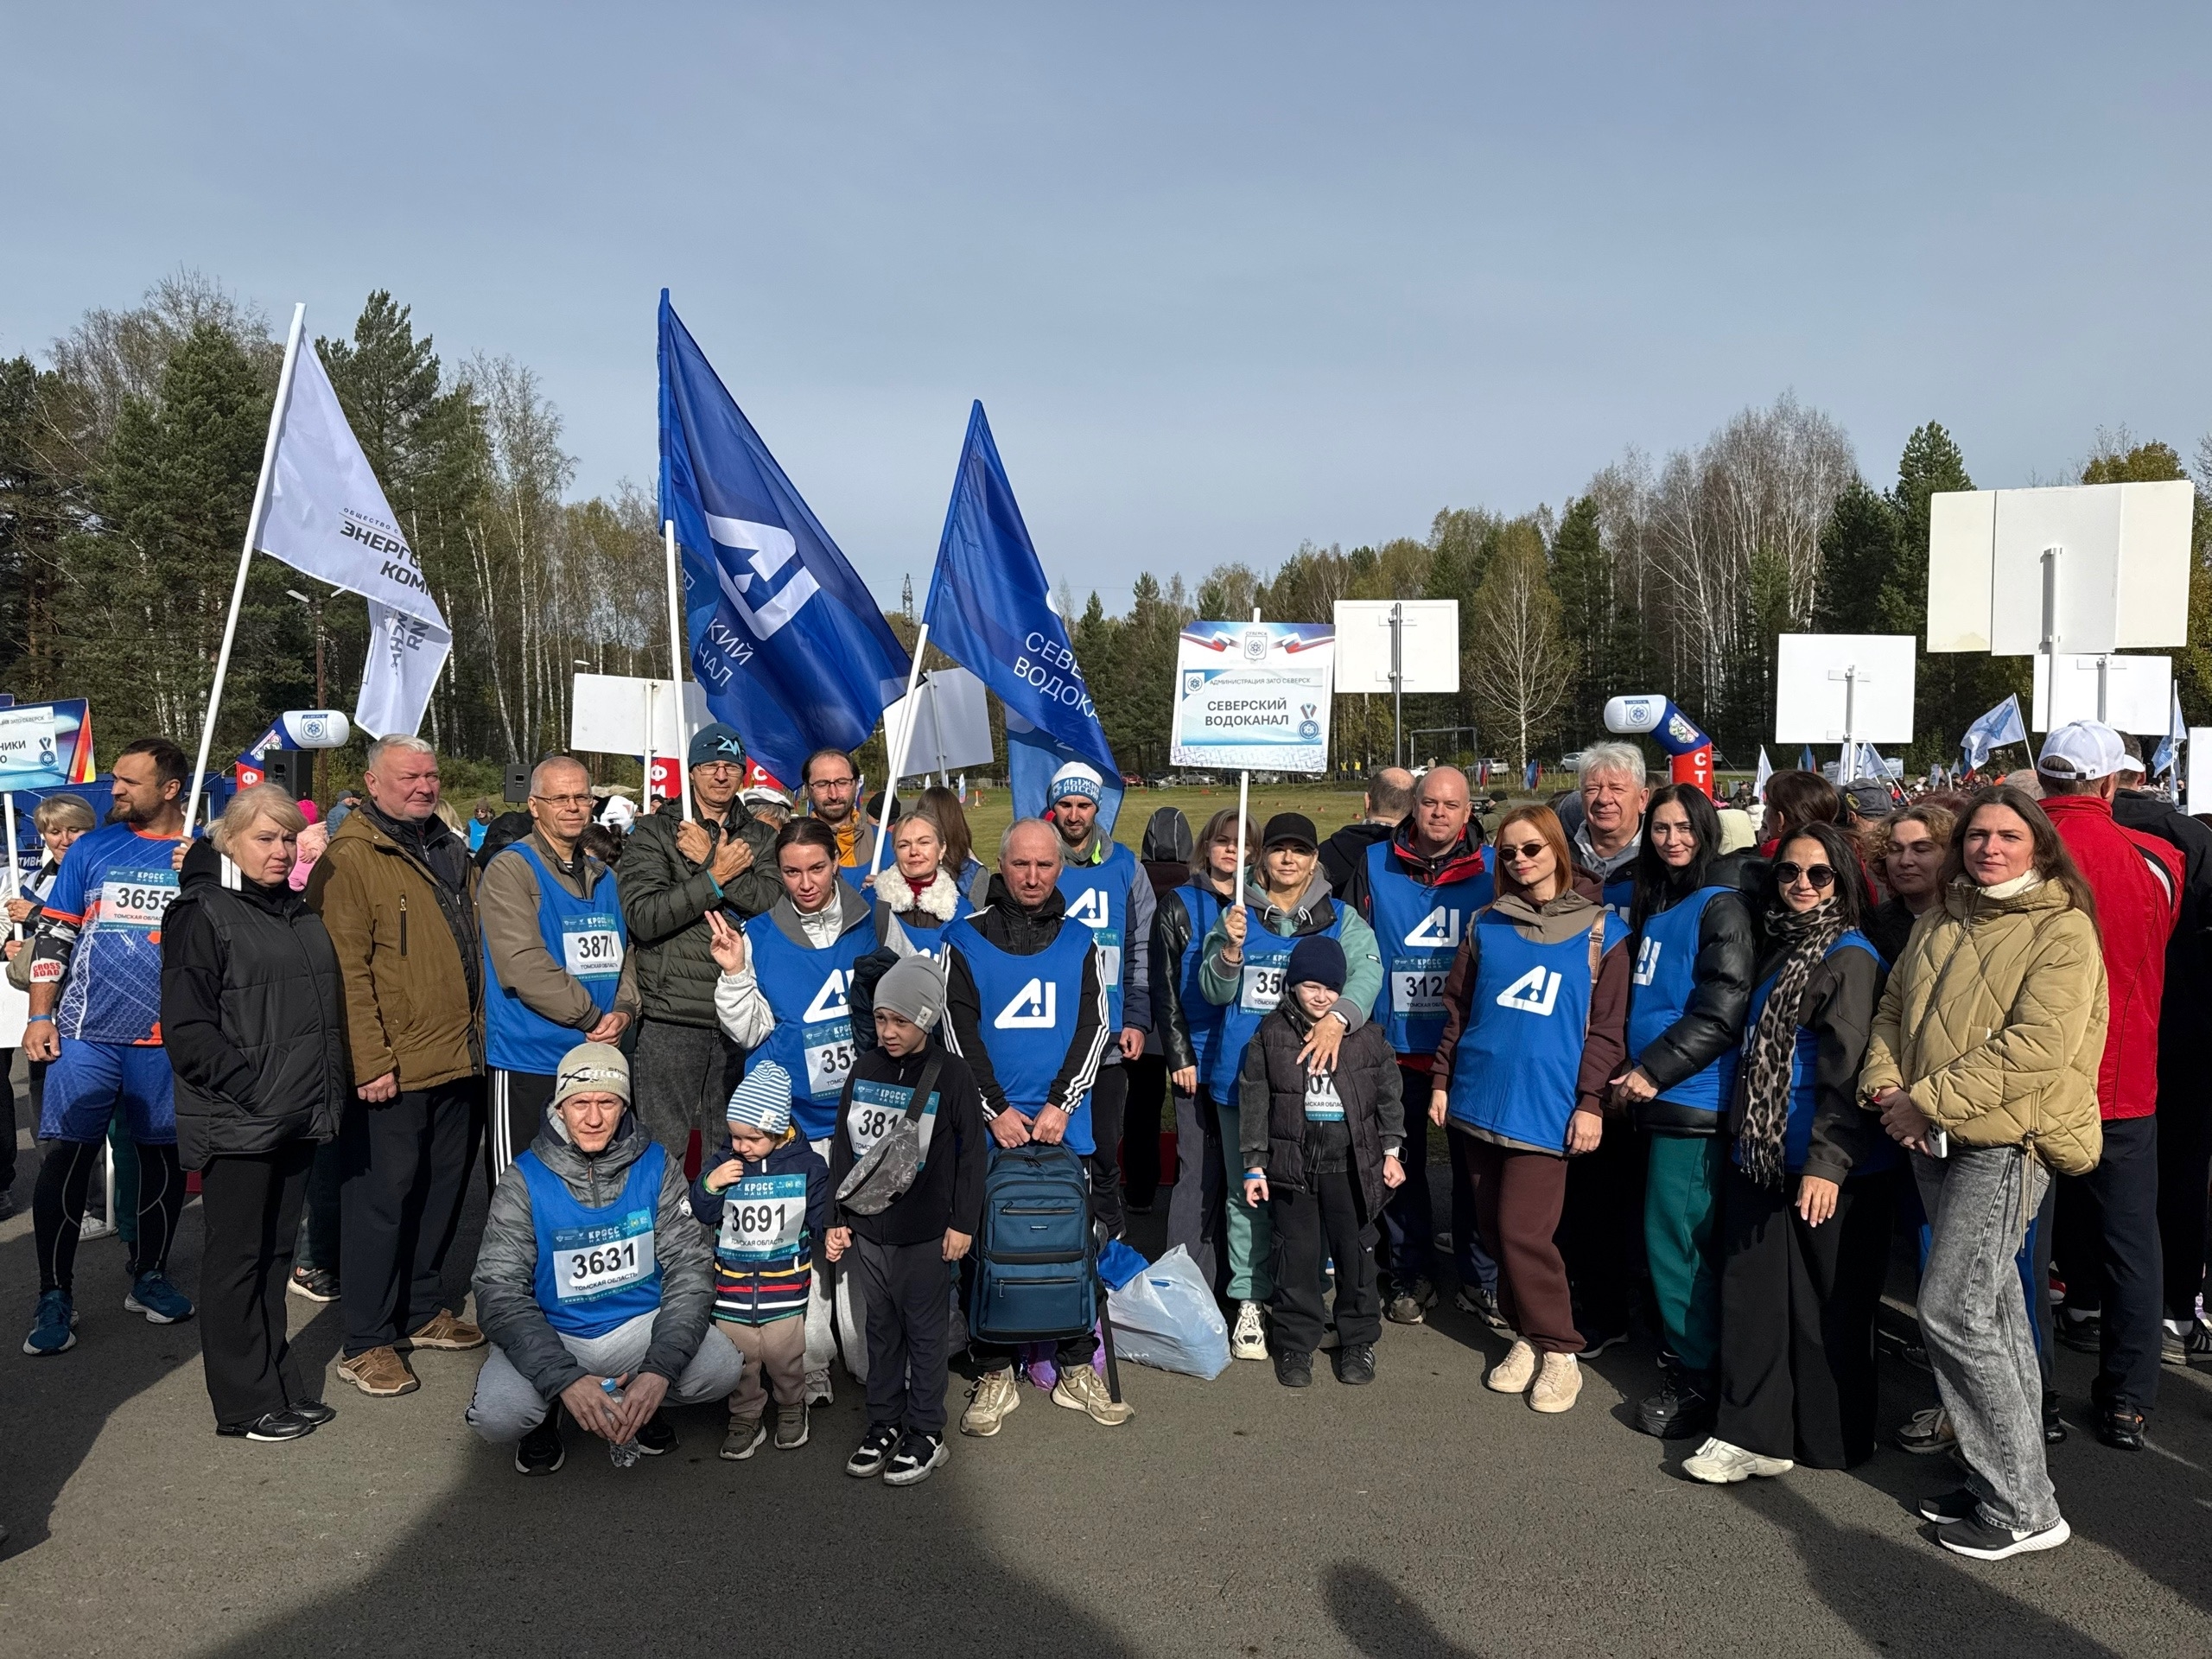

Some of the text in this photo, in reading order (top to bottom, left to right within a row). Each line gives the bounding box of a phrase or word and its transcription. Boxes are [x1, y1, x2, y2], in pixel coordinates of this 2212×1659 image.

[343, 507, 391, 530] ОБЩЕСТВО
[380, 560, 429, 596] КОМ
[1026, 632, 1084, 683] СЕВЕ
[1207, 697, 1287, 711] СЕВЕРСКИЙ
[1205, 715, 1289, 728] ВОДОКАНАЛ
[116, 887, 175, 910] 3655
[33, 962, 61, 973] CROSS
[33, 969, 60, 978] ROAD
[745, 1182, 774, 1192] КРОСС
[732, 1204, 785, 1233] 3691
[588, 1226, 620, 1239] КРОСС
[588, 1234, 620, 1243] НАЦИИ
[571, 1243, 635, 1280] 3631
[575, 1272, 638, 1292] ТОМСКАЯ ОБЛАСТЬ
